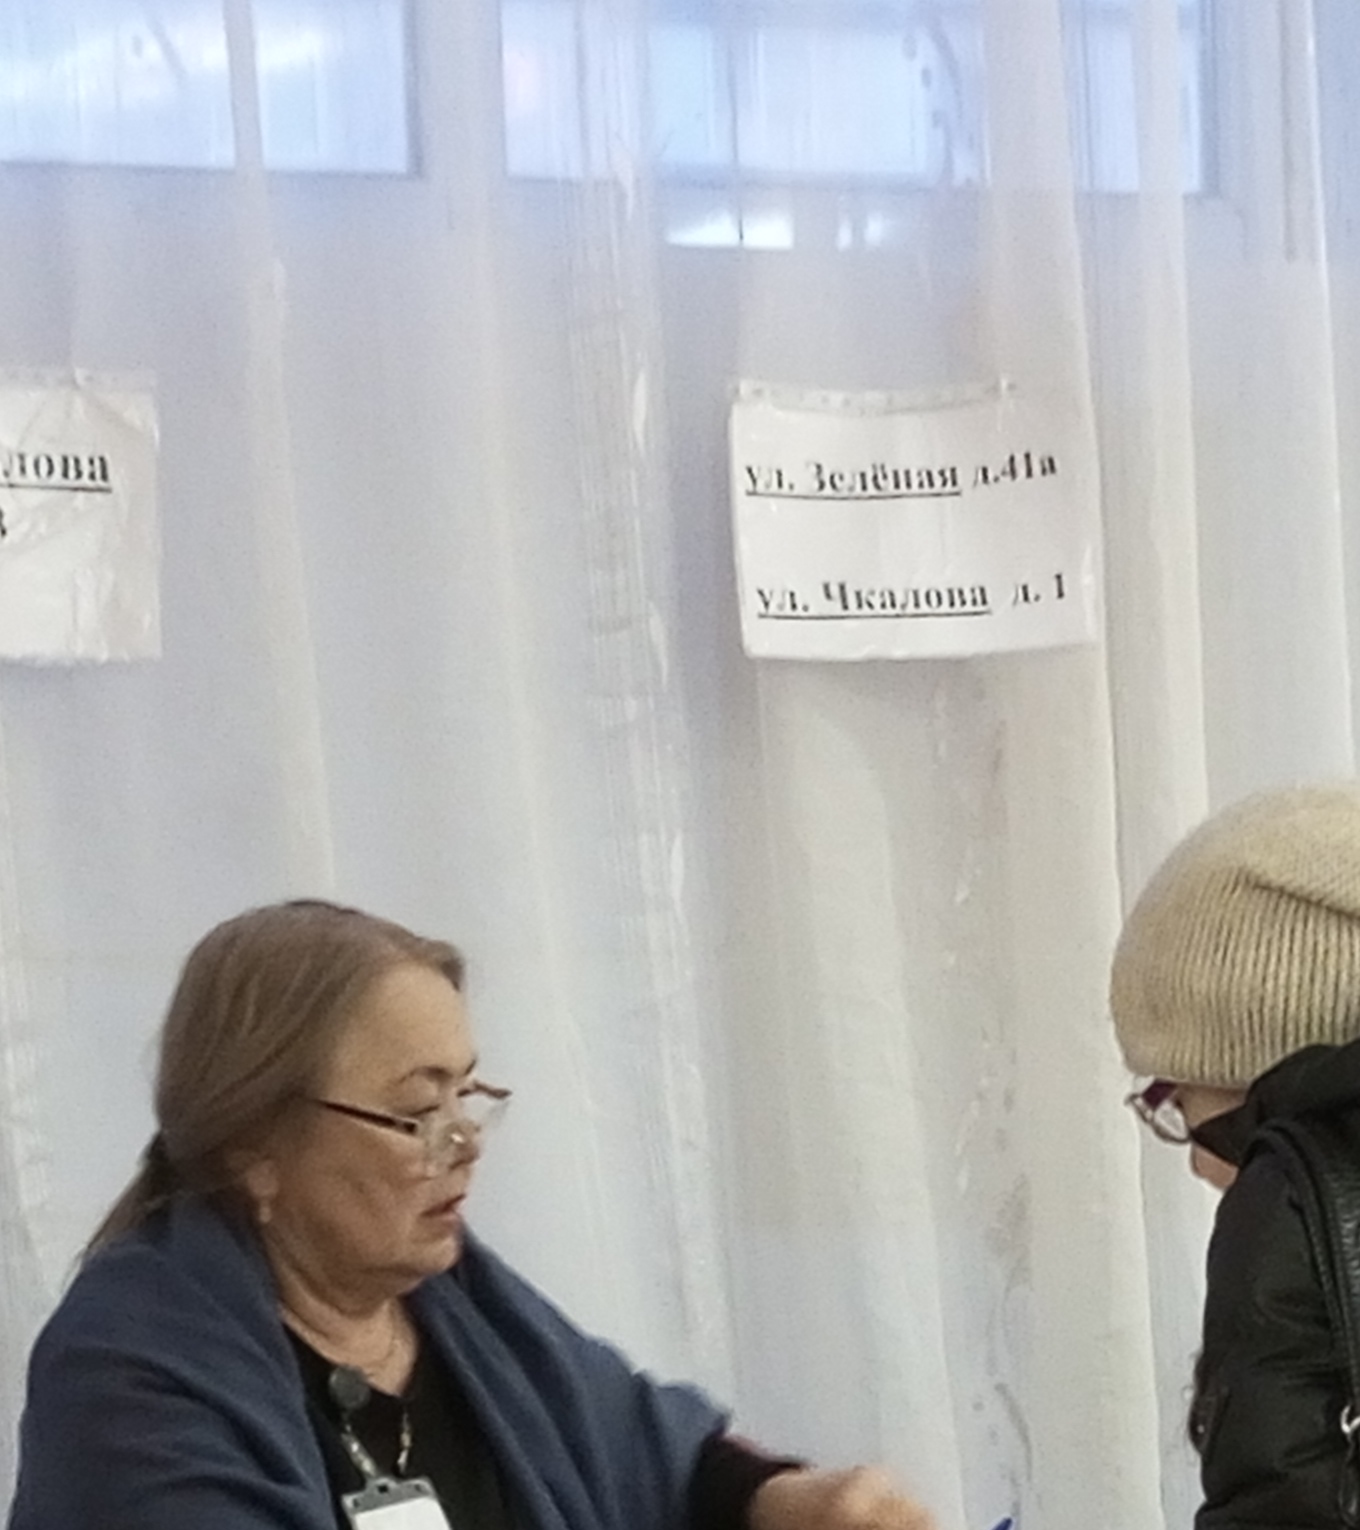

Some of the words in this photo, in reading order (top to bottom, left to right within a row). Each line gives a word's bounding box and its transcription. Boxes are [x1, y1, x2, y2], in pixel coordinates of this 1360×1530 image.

[745, 464, 795, 492] ул.
[812, 461, 959, 493] Зелёная
[756, 586, 810, 613] ул.
[822, 581, 989, 612] Чкалова
[1053, 573, 1066, 600] 1
